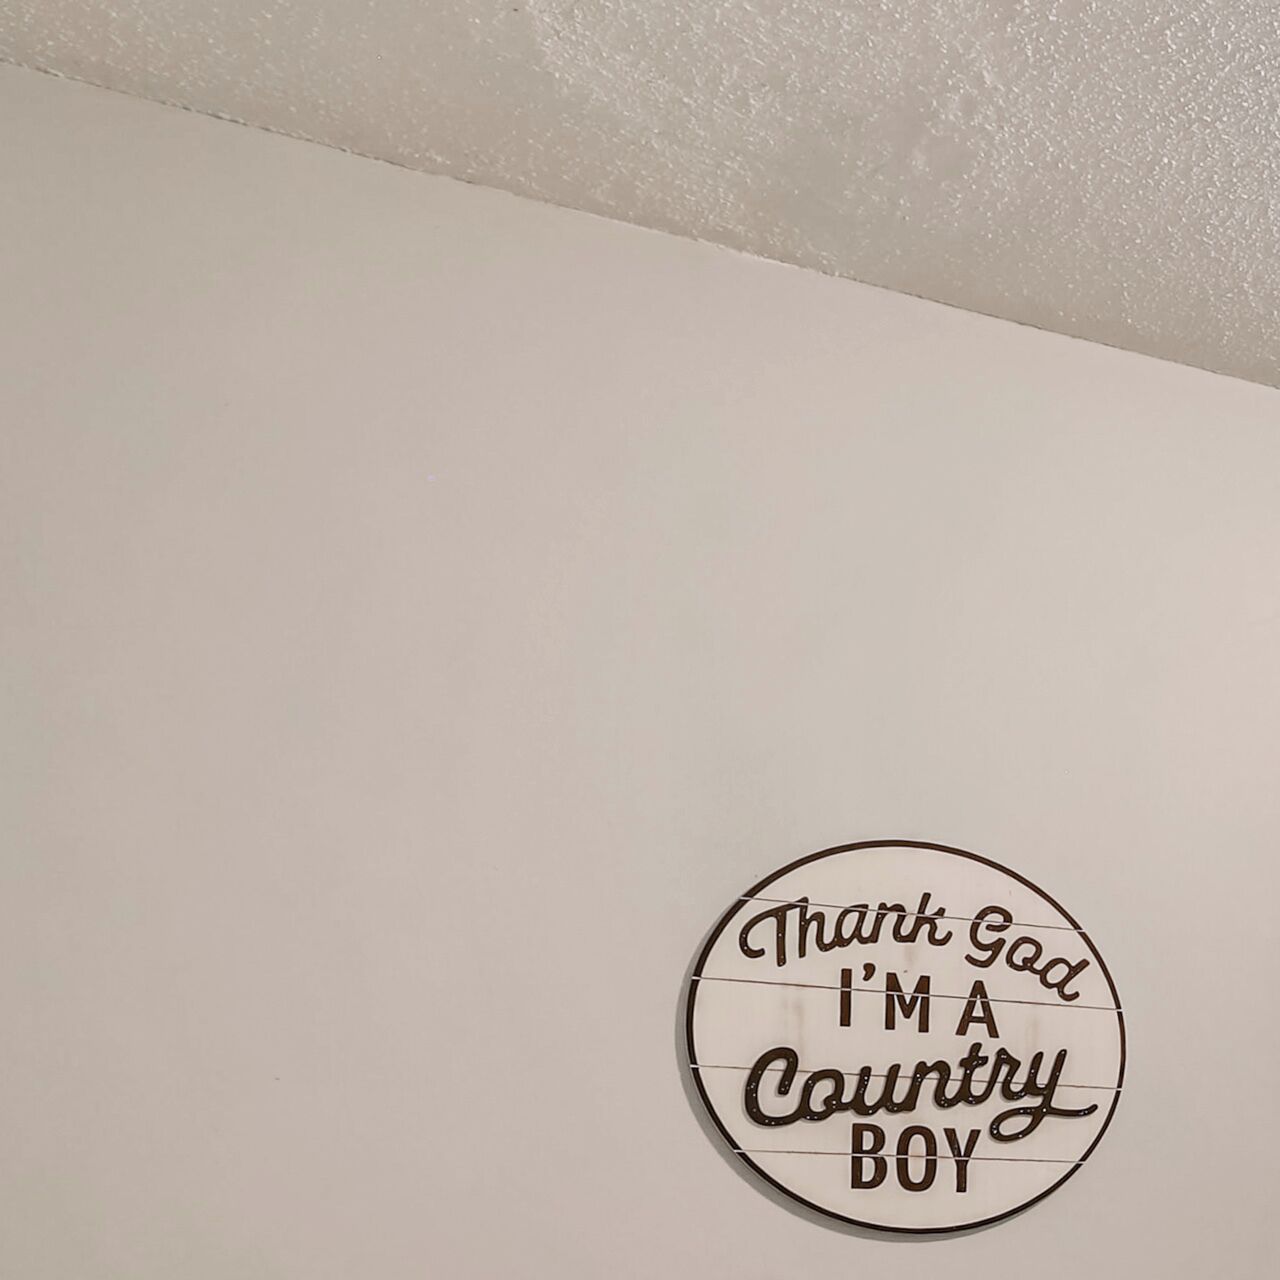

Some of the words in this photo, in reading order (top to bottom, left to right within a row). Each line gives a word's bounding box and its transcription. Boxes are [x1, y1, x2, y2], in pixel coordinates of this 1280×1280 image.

[738, 892, 953, 967] Thank
[964, 905, 1090, 1001] God
[839, 962, 931, 1033] I'M
[955, 980, 1000, 1038] A
[744, 1042, 1098, 1142] Country
[851, 1123, 981, 1193] BOY
